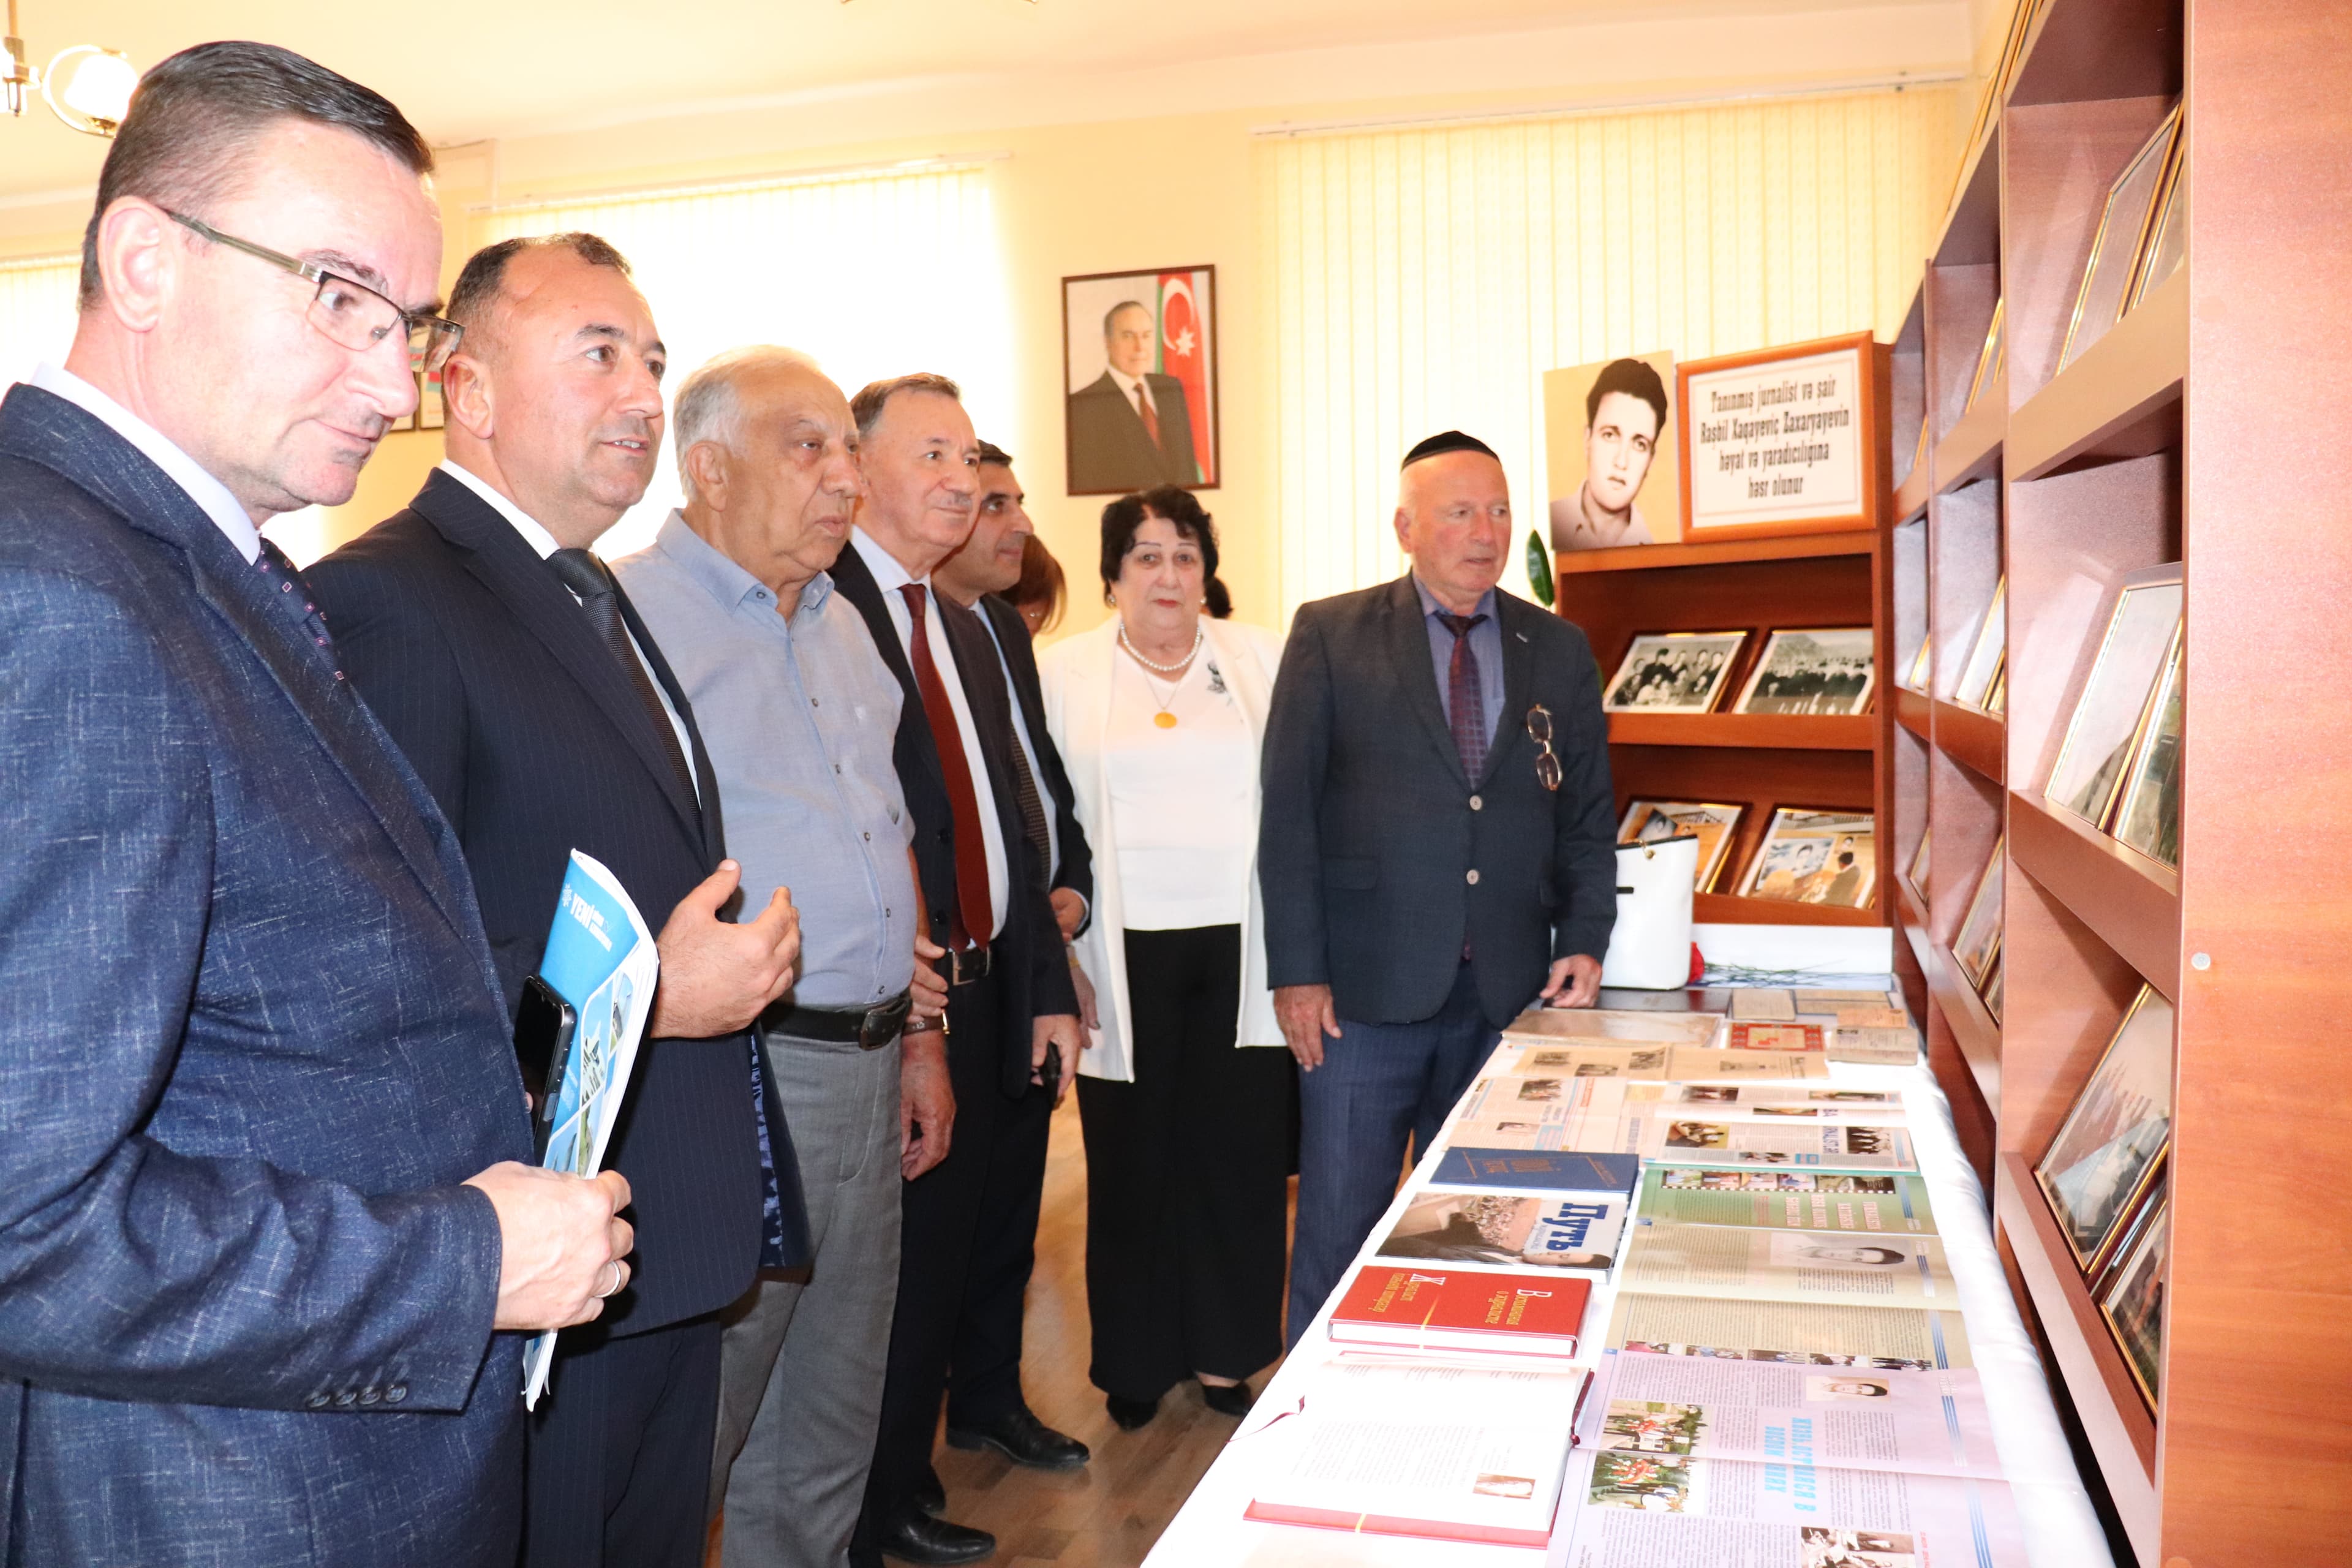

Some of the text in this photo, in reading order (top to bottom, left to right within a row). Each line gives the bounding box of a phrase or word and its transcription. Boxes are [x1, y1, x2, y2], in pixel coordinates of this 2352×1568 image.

[1711, 374, 1836, 415] Tanınmış jurnalist və şair
[1732, 413, 1779, 445] Xaqayeviç
[1783, 404, 1849, 437] Zaxaryayevin
[1719, 450, 1744, 476] həyat
[1748, 451, 1758, 468] və
[1748, 473, 1804, 499] həsr olunur
[1542, 1203, 1608, 1250] Путь
